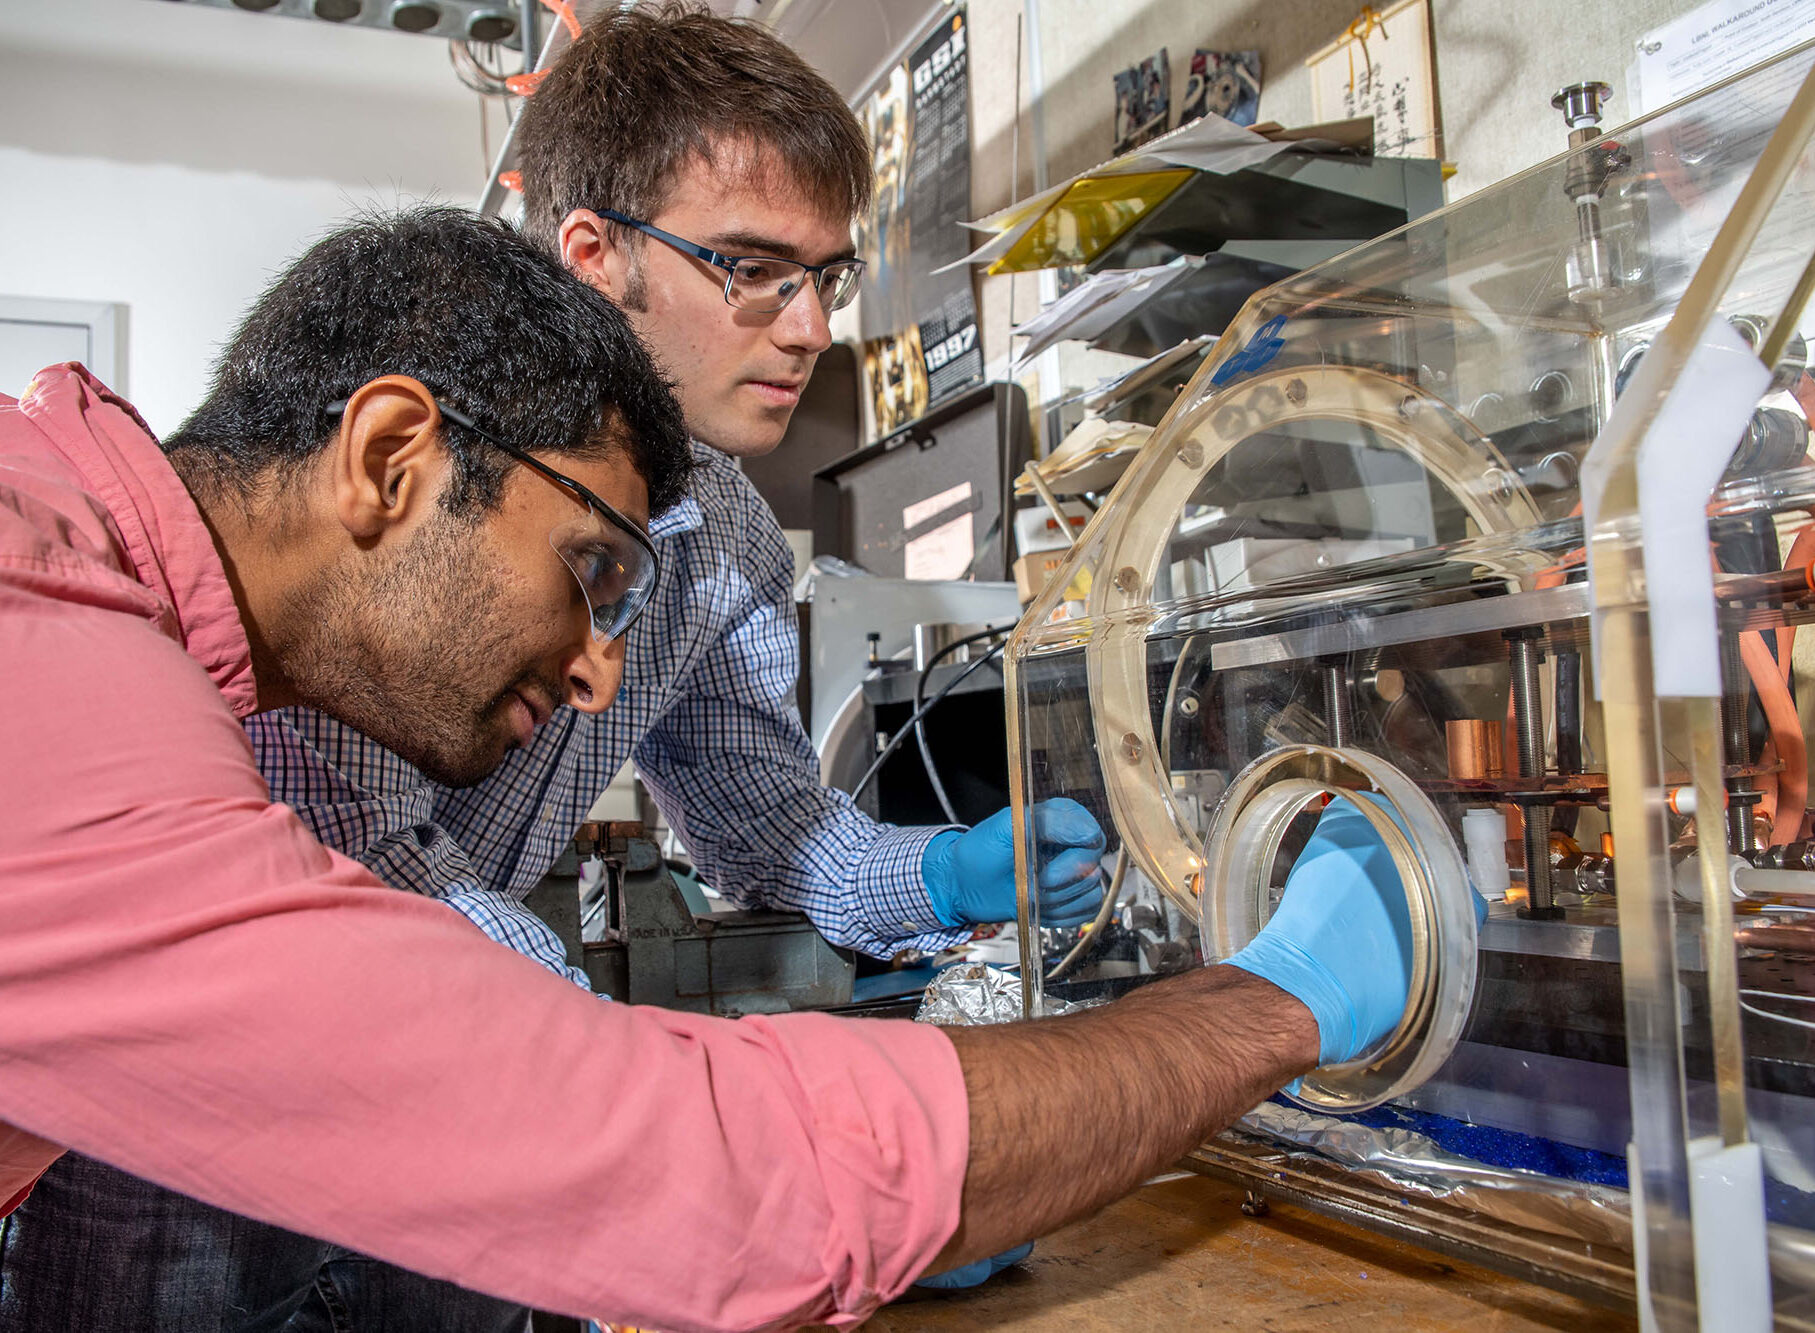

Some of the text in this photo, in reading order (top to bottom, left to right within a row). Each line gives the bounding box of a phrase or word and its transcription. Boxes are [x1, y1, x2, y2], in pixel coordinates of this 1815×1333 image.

[1711, 1, 1766, 33] WALKAROUND
[913, 25, 966, 94] GSI
[924, 323, 977, 372] 1997
[659, 927, 670, 938] IN
